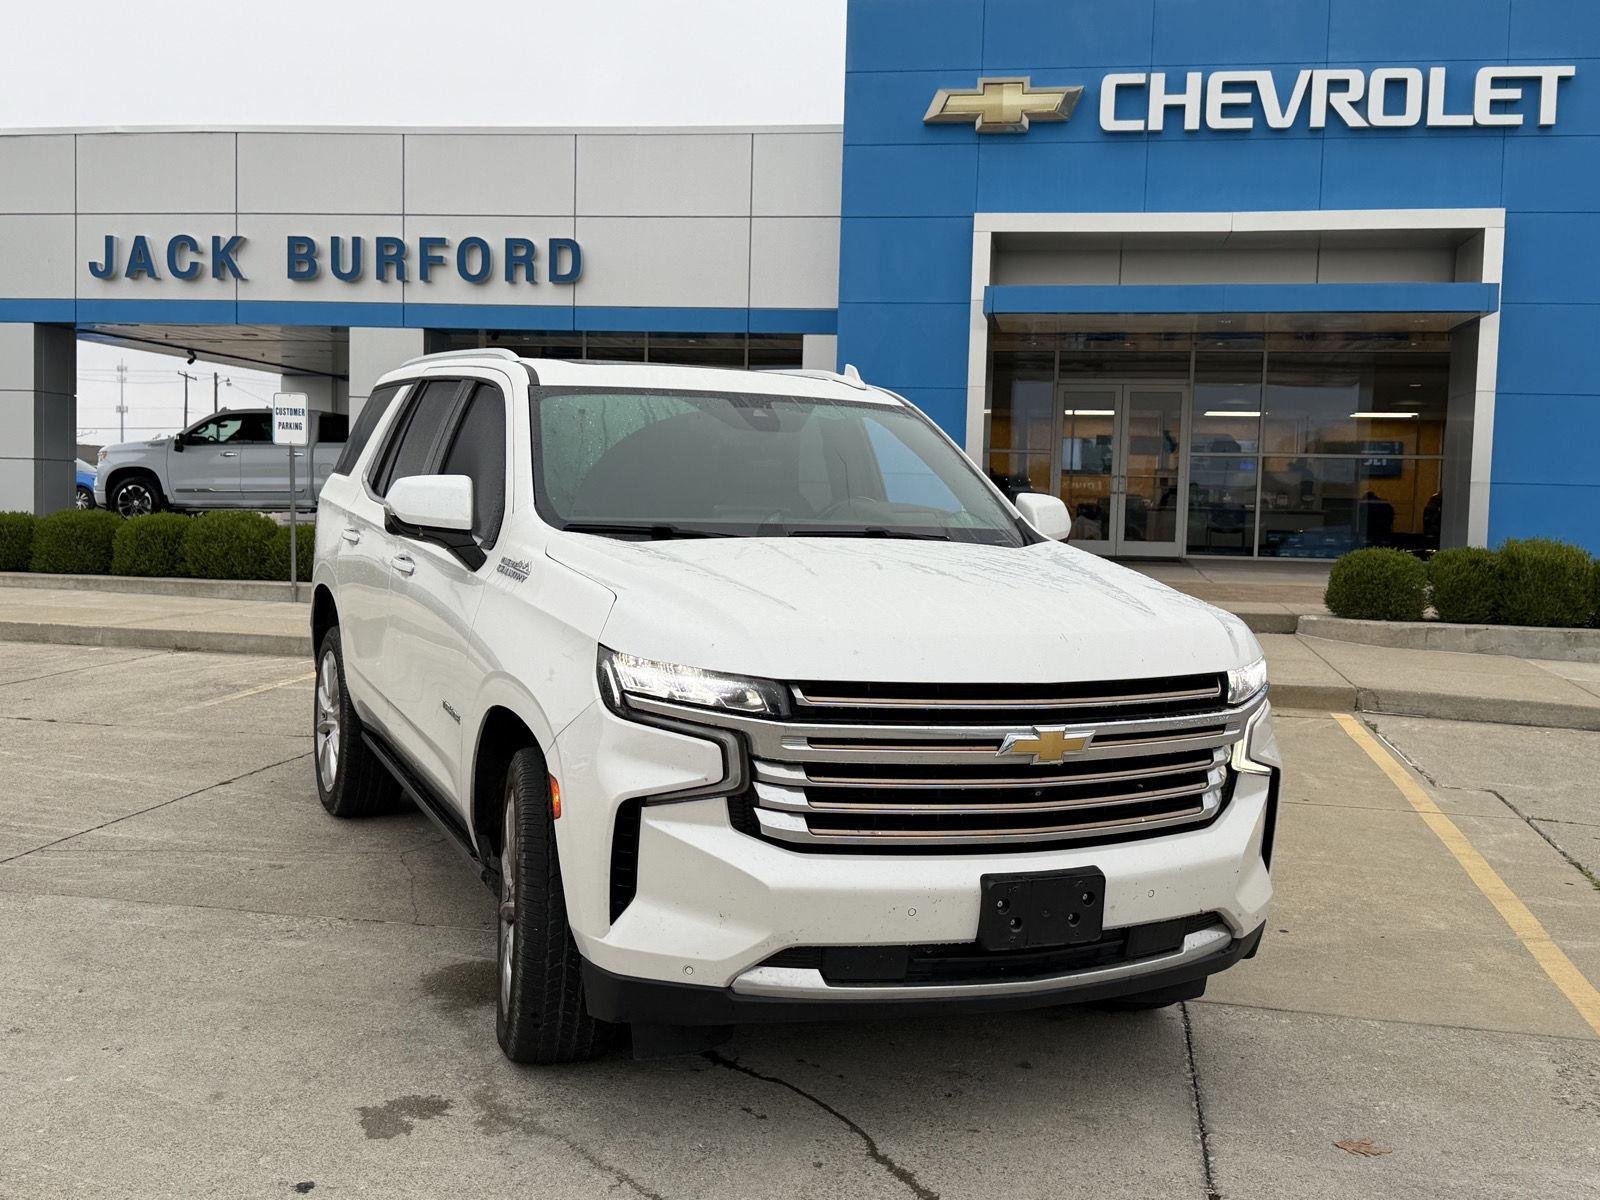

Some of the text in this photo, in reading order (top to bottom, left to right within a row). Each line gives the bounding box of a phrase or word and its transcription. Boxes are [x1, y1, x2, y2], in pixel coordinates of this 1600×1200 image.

[1100, 66, 1575, 132] CHEVROLET
[89, 234, 583, 284] JACK BURFORD
[275, 407, 305, 417] CUSTOMER
[277, 421, 303, 431] PARKING
